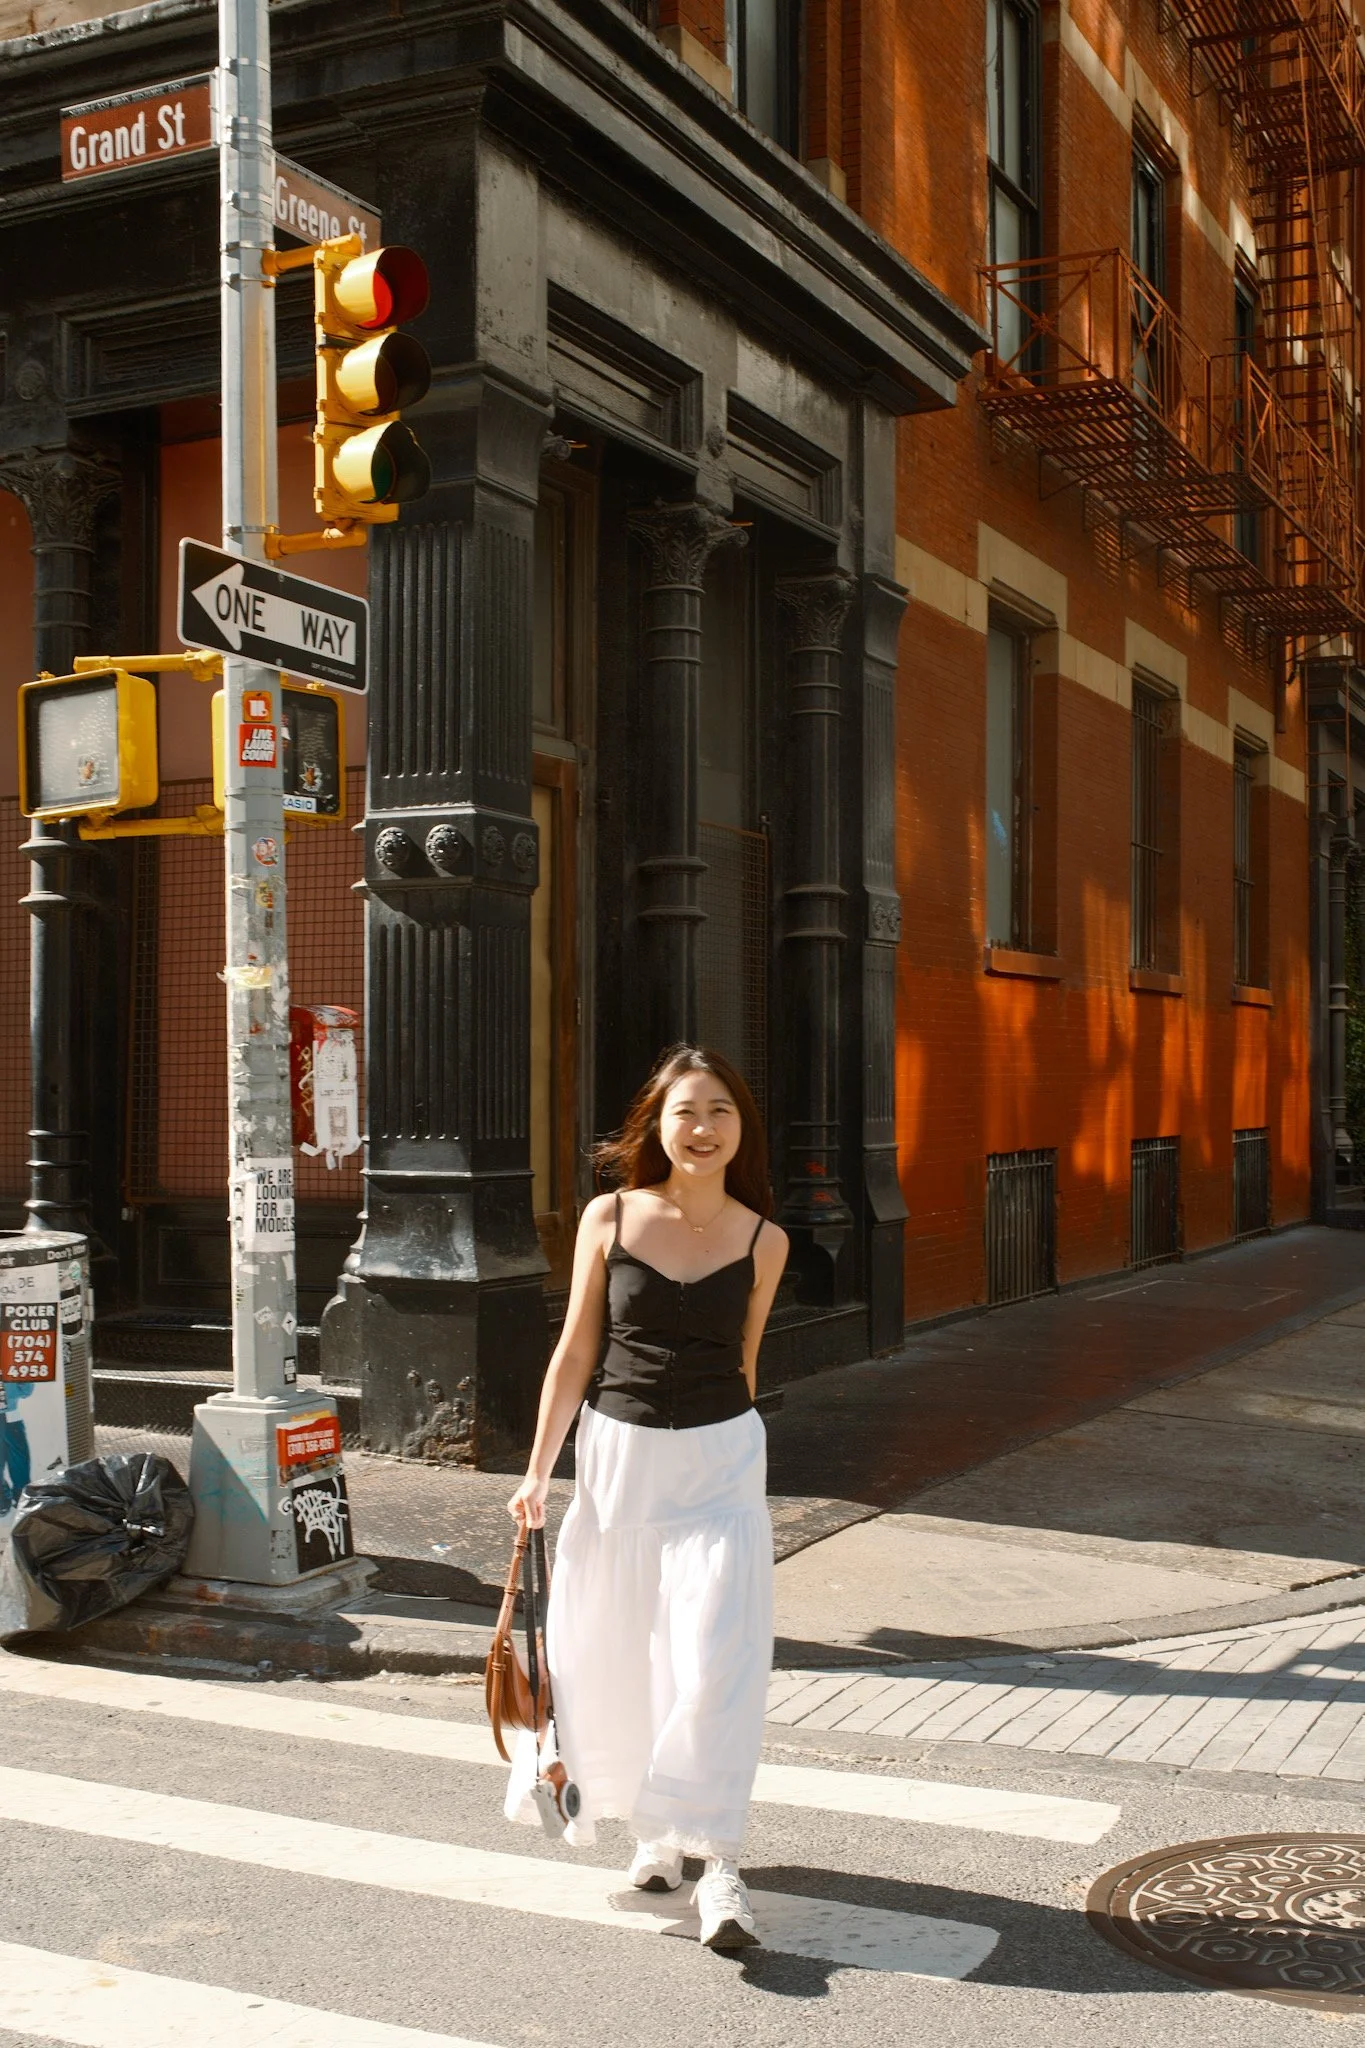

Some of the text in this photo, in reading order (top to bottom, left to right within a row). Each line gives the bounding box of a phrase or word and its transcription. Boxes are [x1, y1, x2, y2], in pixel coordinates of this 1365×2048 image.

[70, 102, 186, 170] Grand St
[275, 175, 340, 240] Greene
[216, 583, 349, 656] ONE WAY
[252, 728, 273, 739] LIVE
[244, 739, 275, 750] LAUGH
[242, 750, 275, 761] COUNT
[256, 1169, 292, 1184] WE ARE
[256, 1202, 277, 1217] FOR
[255, 1217, 295, 1233] MODELS
[5, 1305, 55, 1317] POKER
[10, 1319, 50, 1331] CLUB
[7, 1335, 51, 1348] (704)
[14, 1350, 44, 1362] 574
[7, 1365, 49, 1377] 4958
